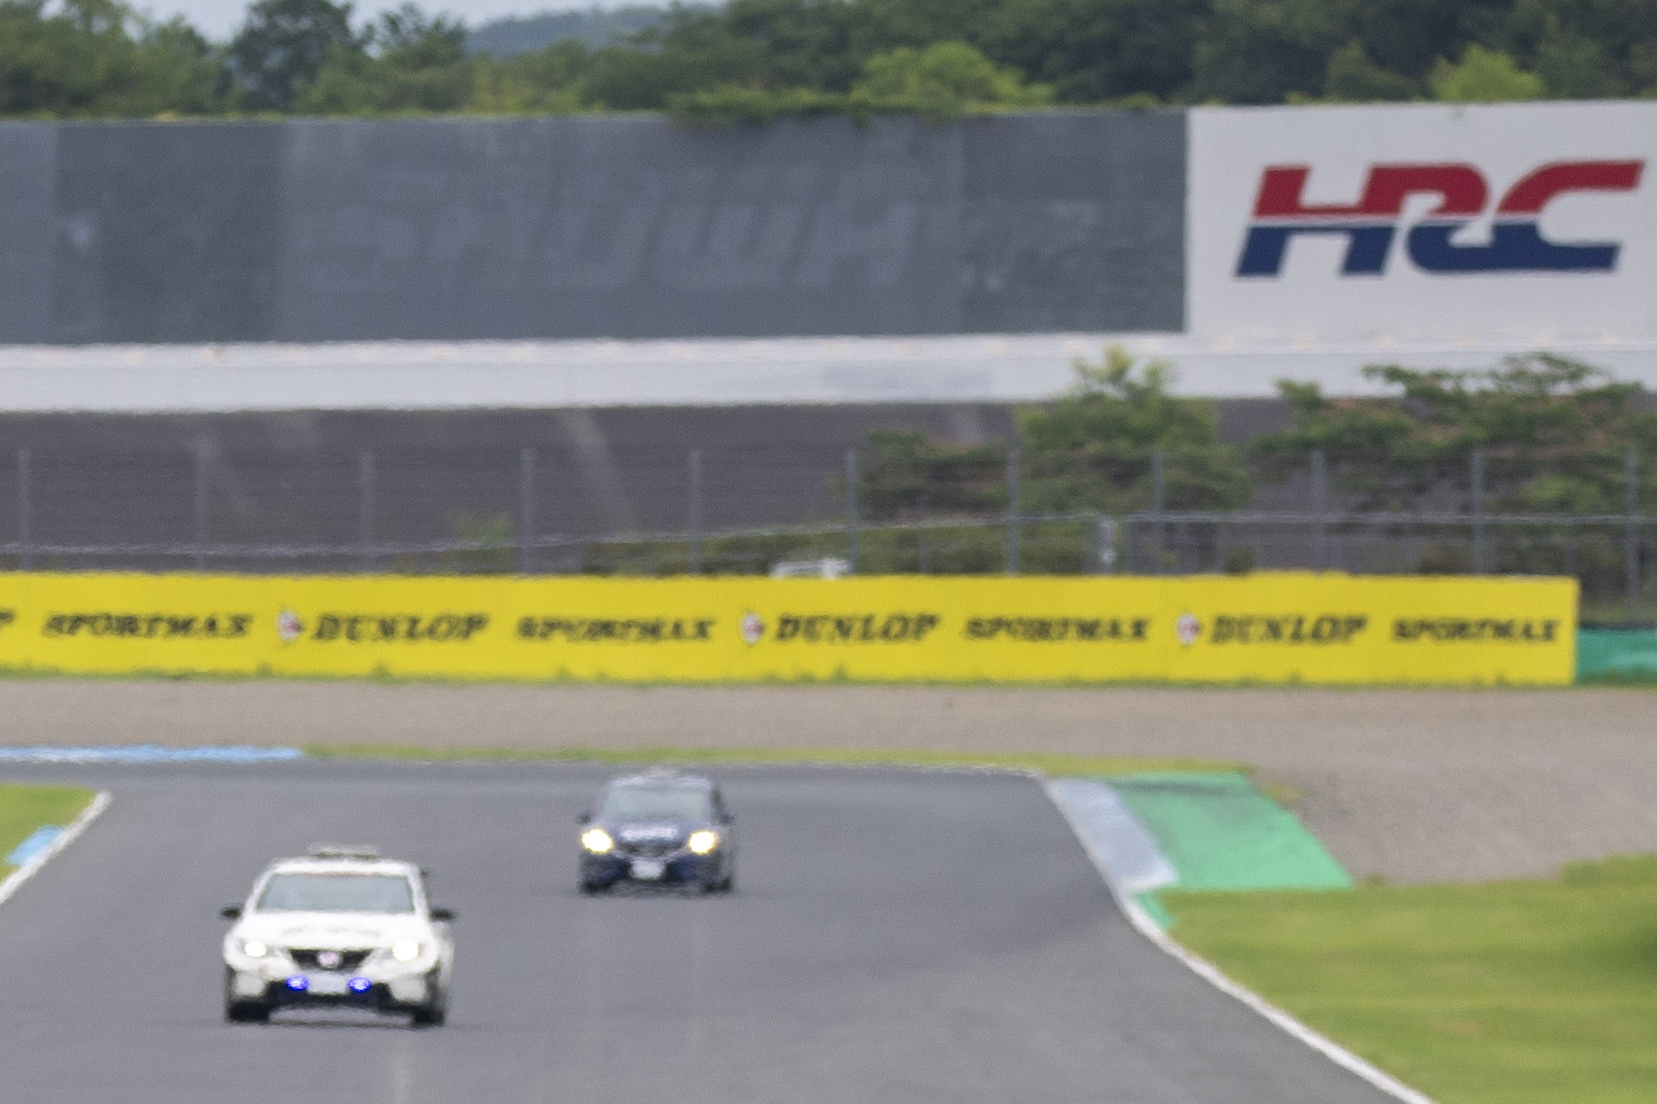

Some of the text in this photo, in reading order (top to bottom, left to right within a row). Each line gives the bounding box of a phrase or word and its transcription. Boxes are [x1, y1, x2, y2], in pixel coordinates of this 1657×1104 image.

[1235, 158, 1647, 278] HRC
[40, 611, 256, 641] SPORTMAX
[309, 610, 492, 643] DUNLOP
[513, 615, 717, 644] SPORTMAX
[773, 612, 941, 644] DUNLOP
[961, 614, 1152, 644] SPORTMAX
[1209, 612, 1369, 645] DUNLOP
[1390, 617, 1560, 645] SPORTMAX
